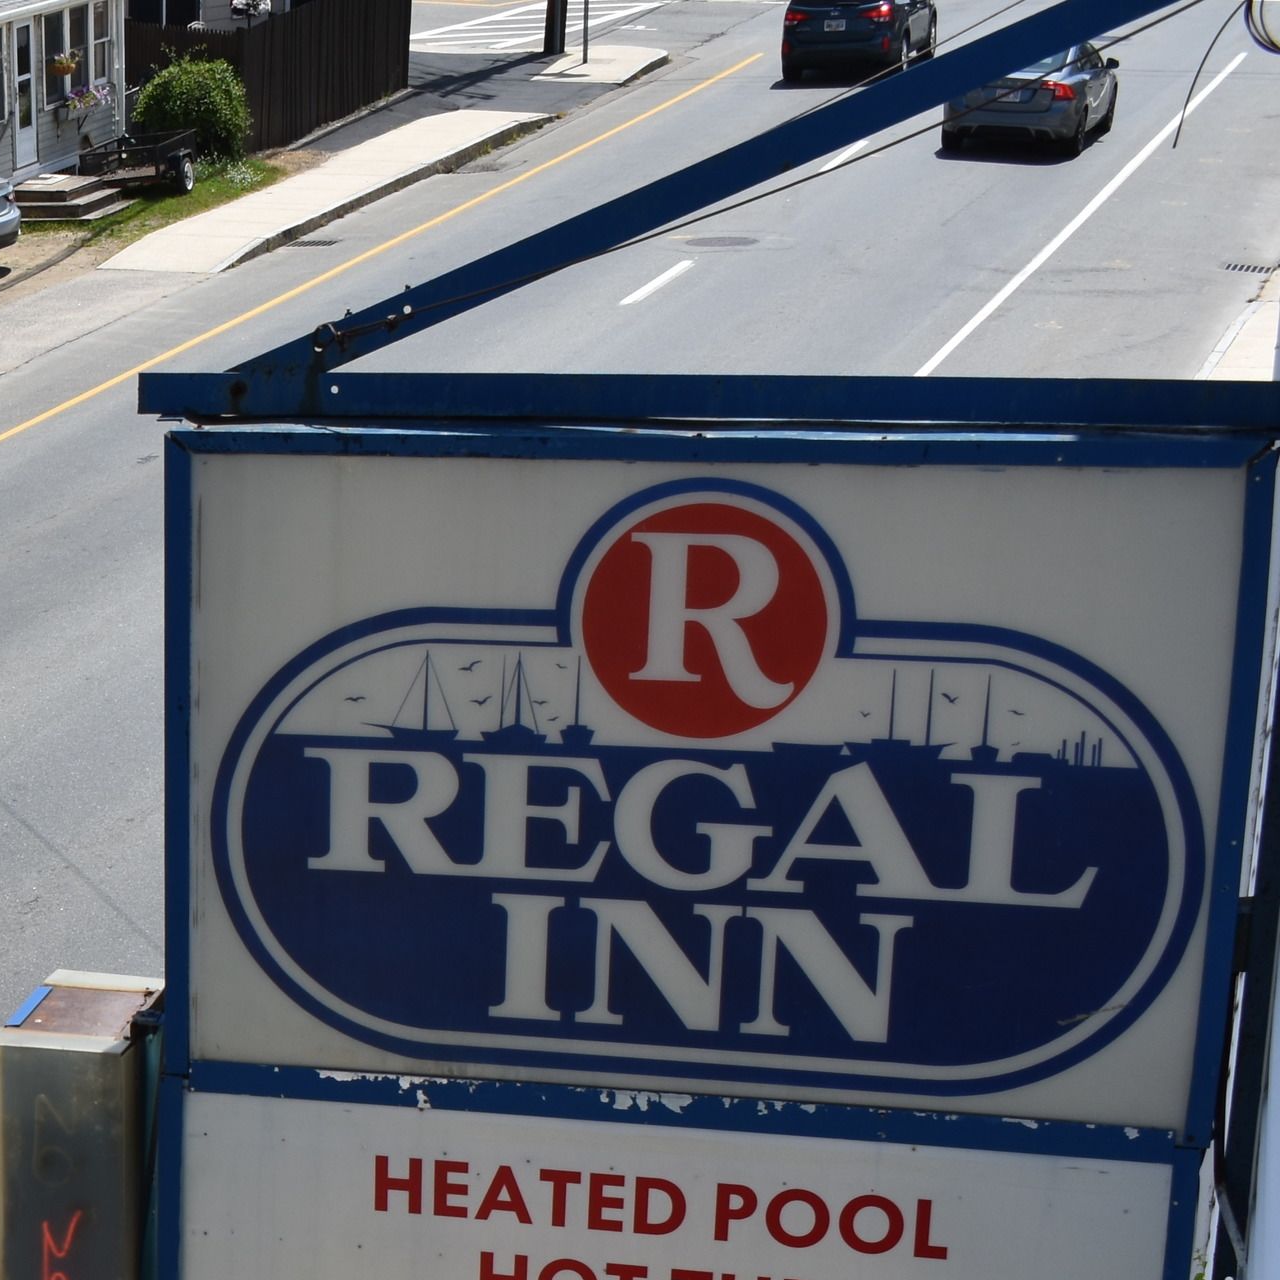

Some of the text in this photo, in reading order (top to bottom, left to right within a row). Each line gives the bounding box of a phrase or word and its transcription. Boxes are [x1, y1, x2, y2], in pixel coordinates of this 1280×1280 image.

[629, 530, 795, 710] R
[302, 746, 1100, 910] REGAL
[486, 892, 915, 1045] INN
[373, 1154, 948, 1260] HEATED POOL
